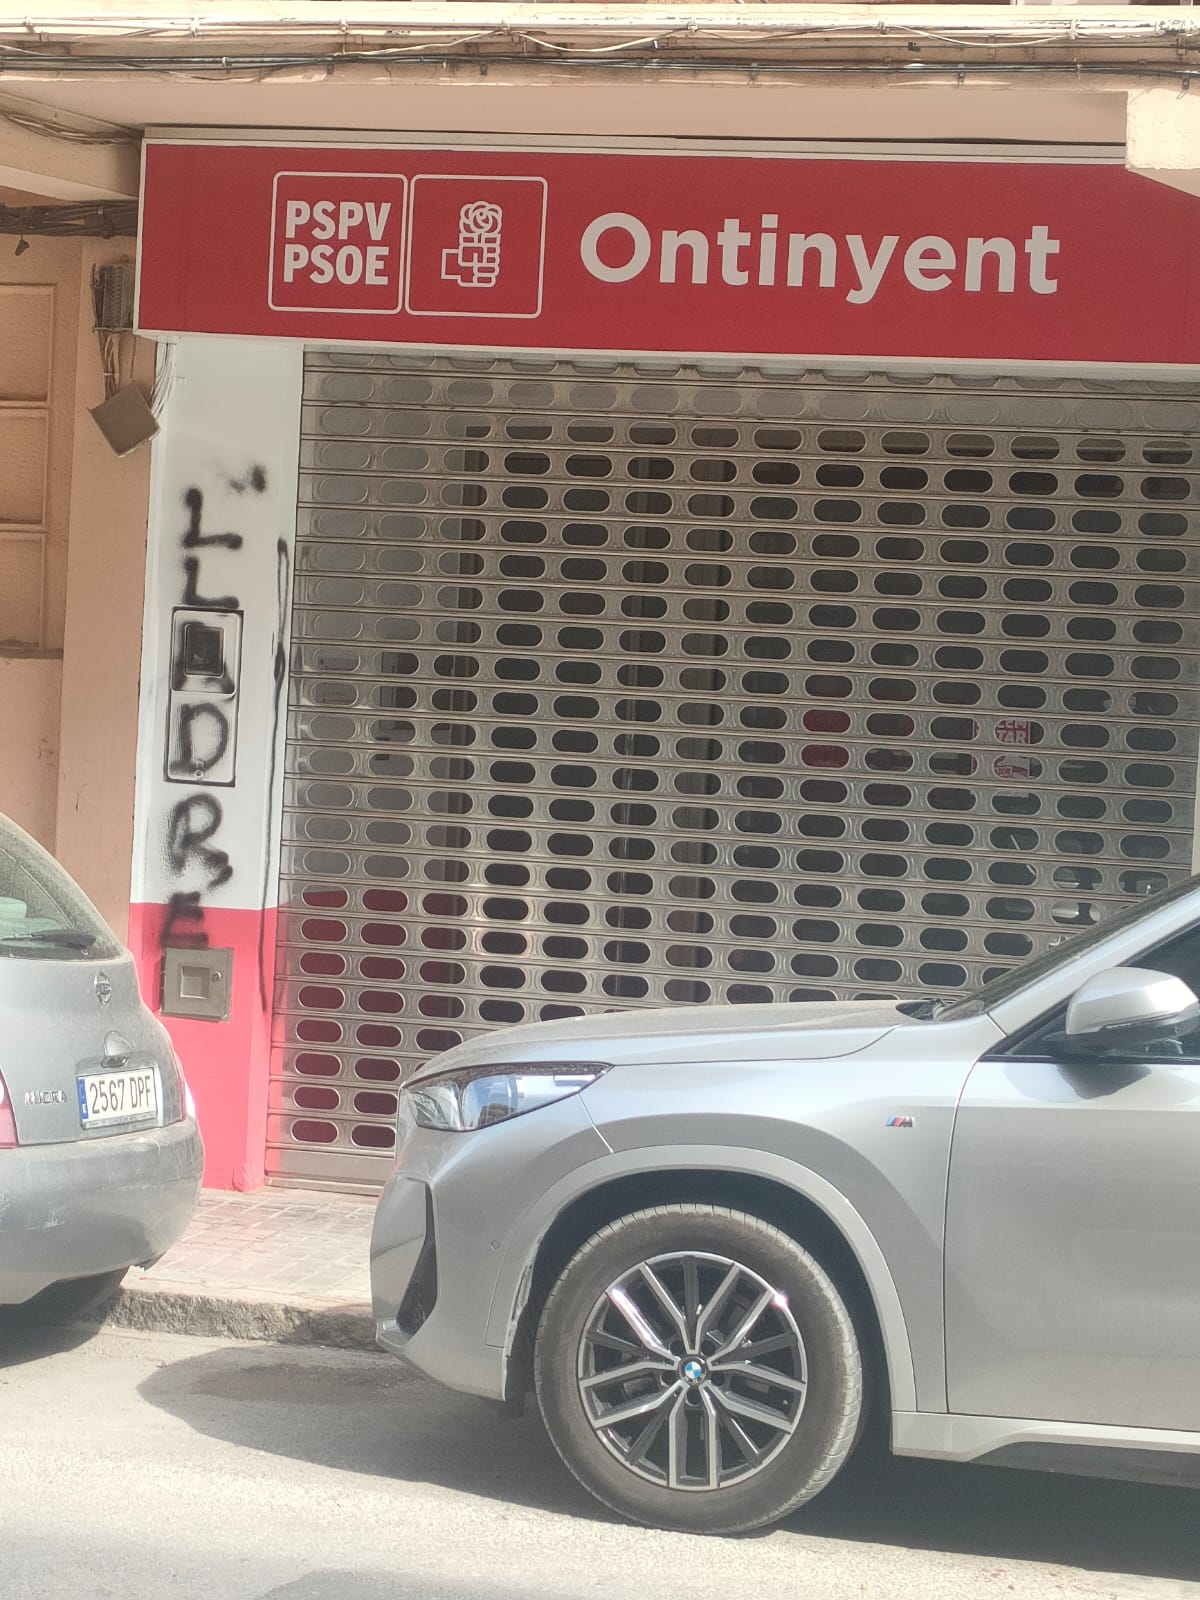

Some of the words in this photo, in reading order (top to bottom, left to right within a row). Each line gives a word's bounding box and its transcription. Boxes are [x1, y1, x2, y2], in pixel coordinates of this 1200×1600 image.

[285, 200, 392, 241] PSPV
[283, 243, 390, 285] PSOE
[580, 212, 1060, 304] Ontinyent
[89, 1079, 125, 1115] 2567
[129, 1074, 151, 1109] DPF
